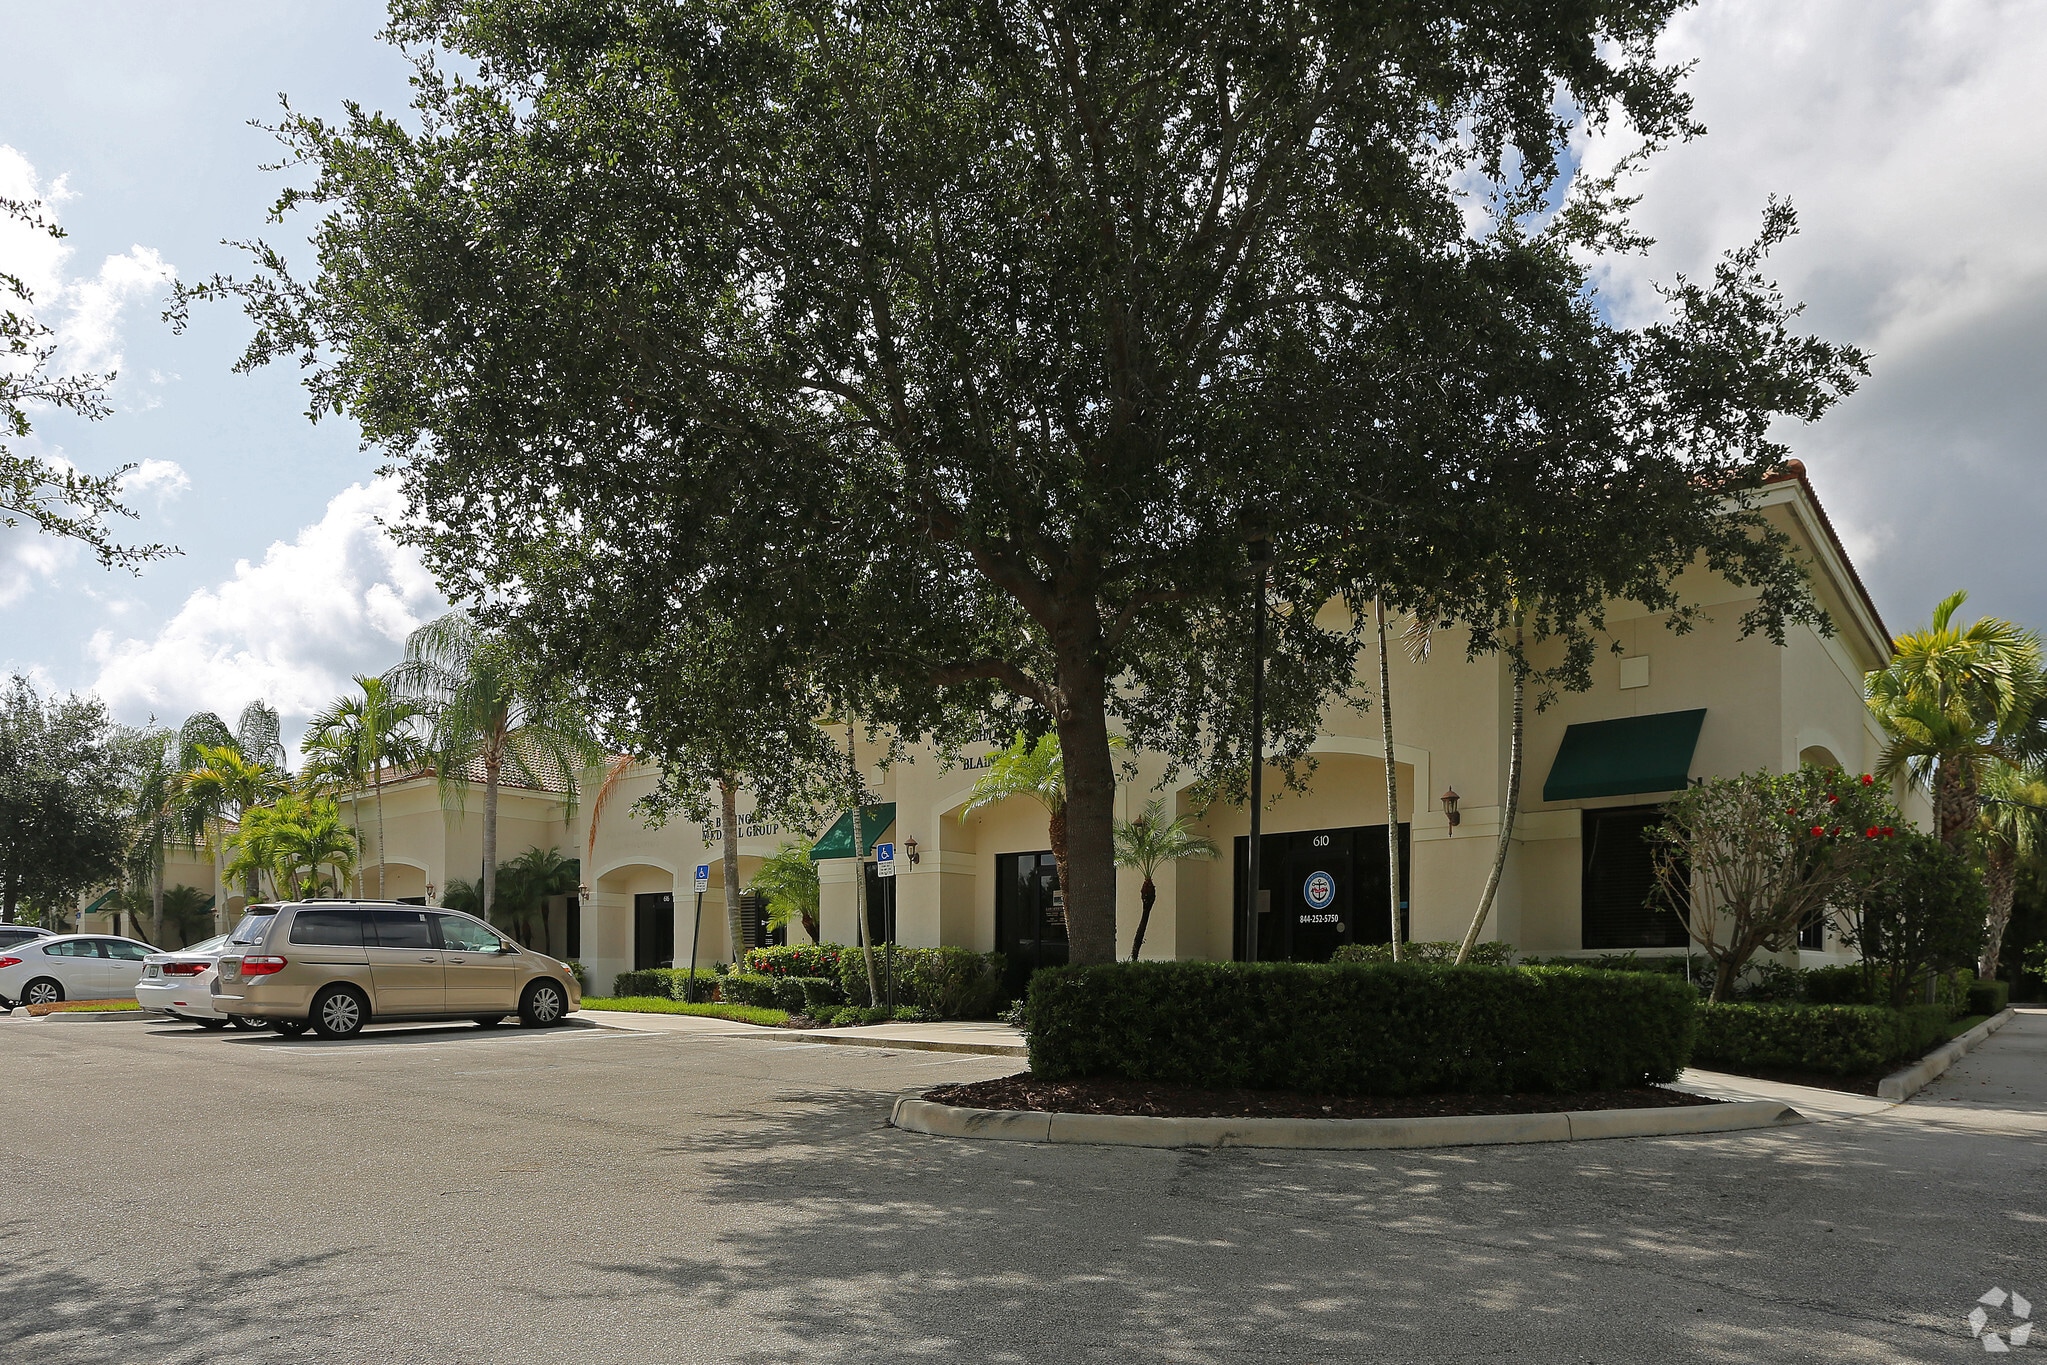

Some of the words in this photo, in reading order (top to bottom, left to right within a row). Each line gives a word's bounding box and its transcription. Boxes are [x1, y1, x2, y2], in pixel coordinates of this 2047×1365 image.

[746, 824, 779, 837] GROUP
[1313, 835, 1330, 847] 610
[1299, 914, 1339, 924] 844-252-5750
